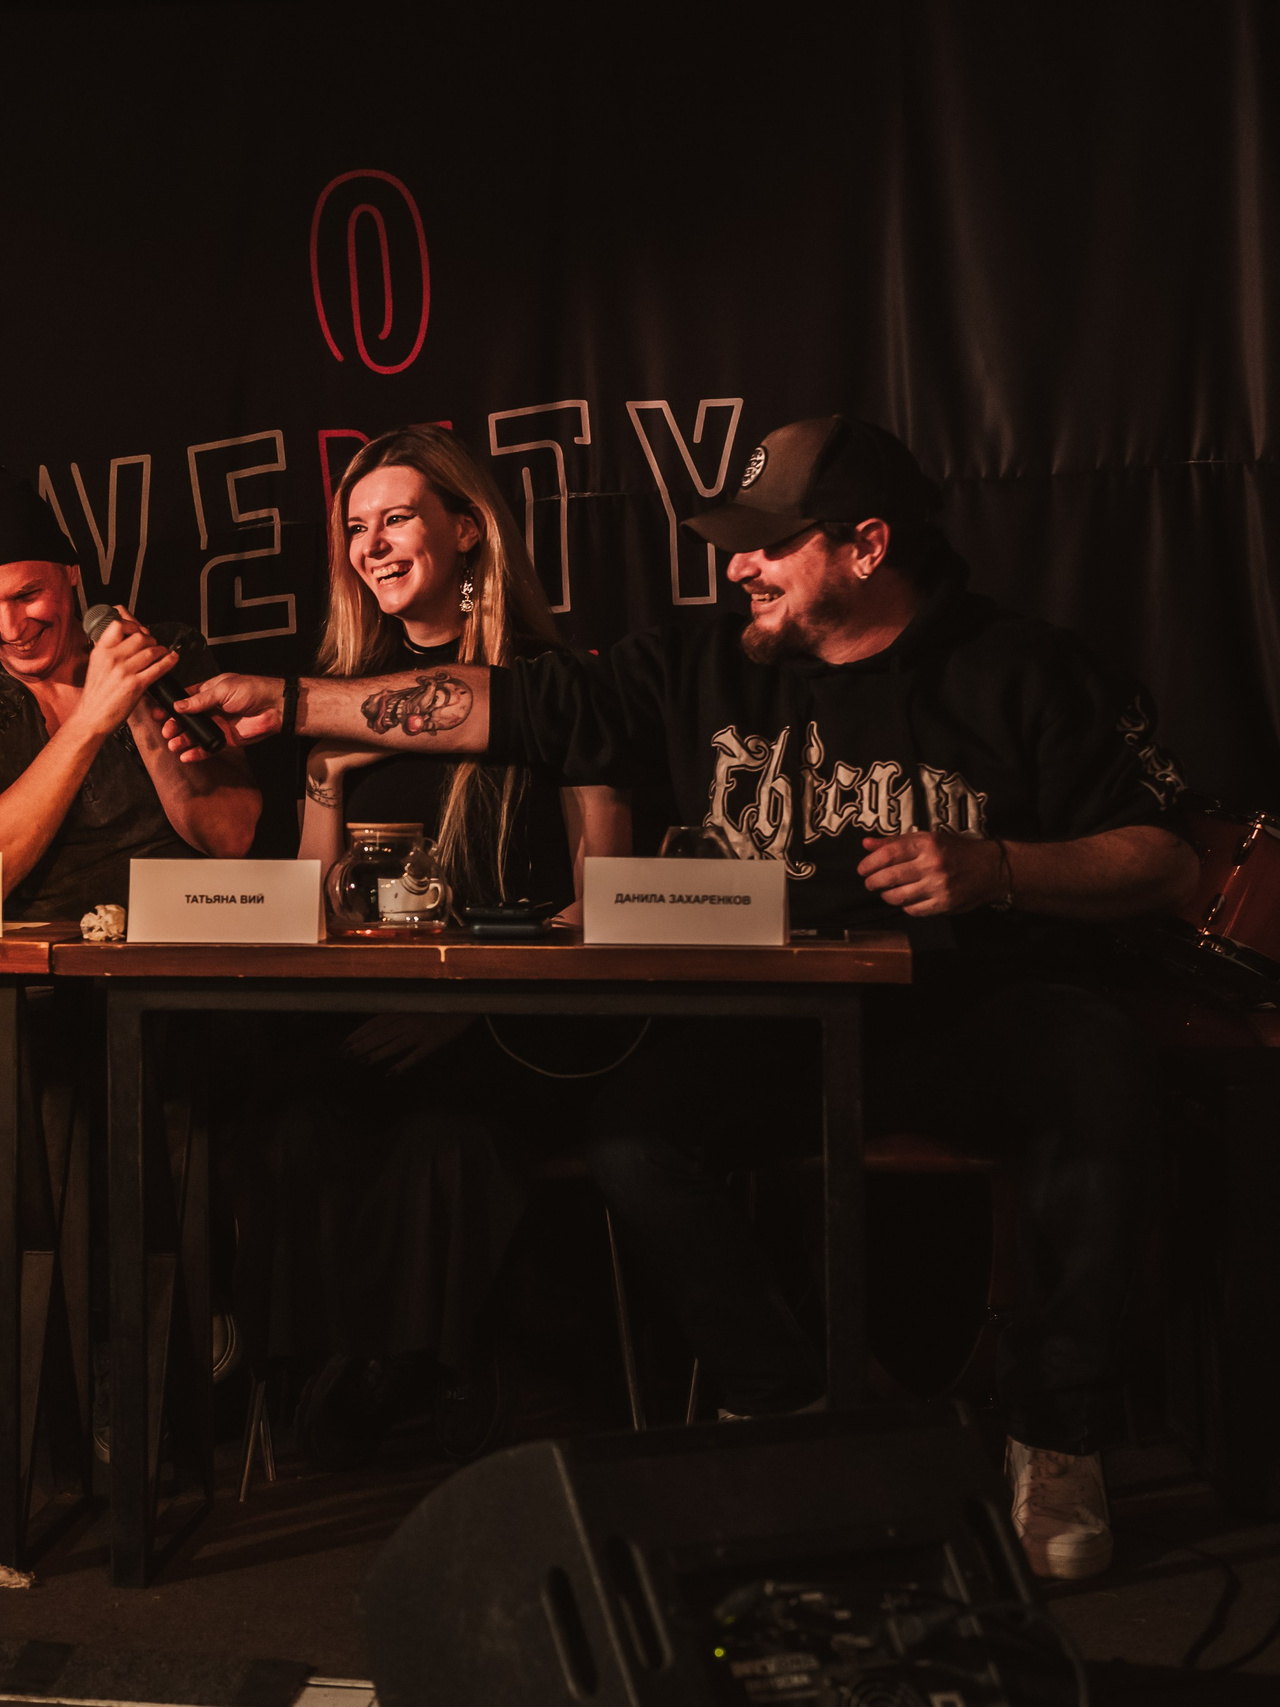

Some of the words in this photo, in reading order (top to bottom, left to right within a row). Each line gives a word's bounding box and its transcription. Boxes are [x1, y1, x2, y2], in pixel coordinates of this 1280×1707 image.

[185, 894, 237, 904] ТАТЬЯНА
[240, 893, 265, 904] ВИЙ
[614, 893, 666, 904] ДАНИЛА
[668, 894, 752, 905] ЗАХАРЕНКОВ
